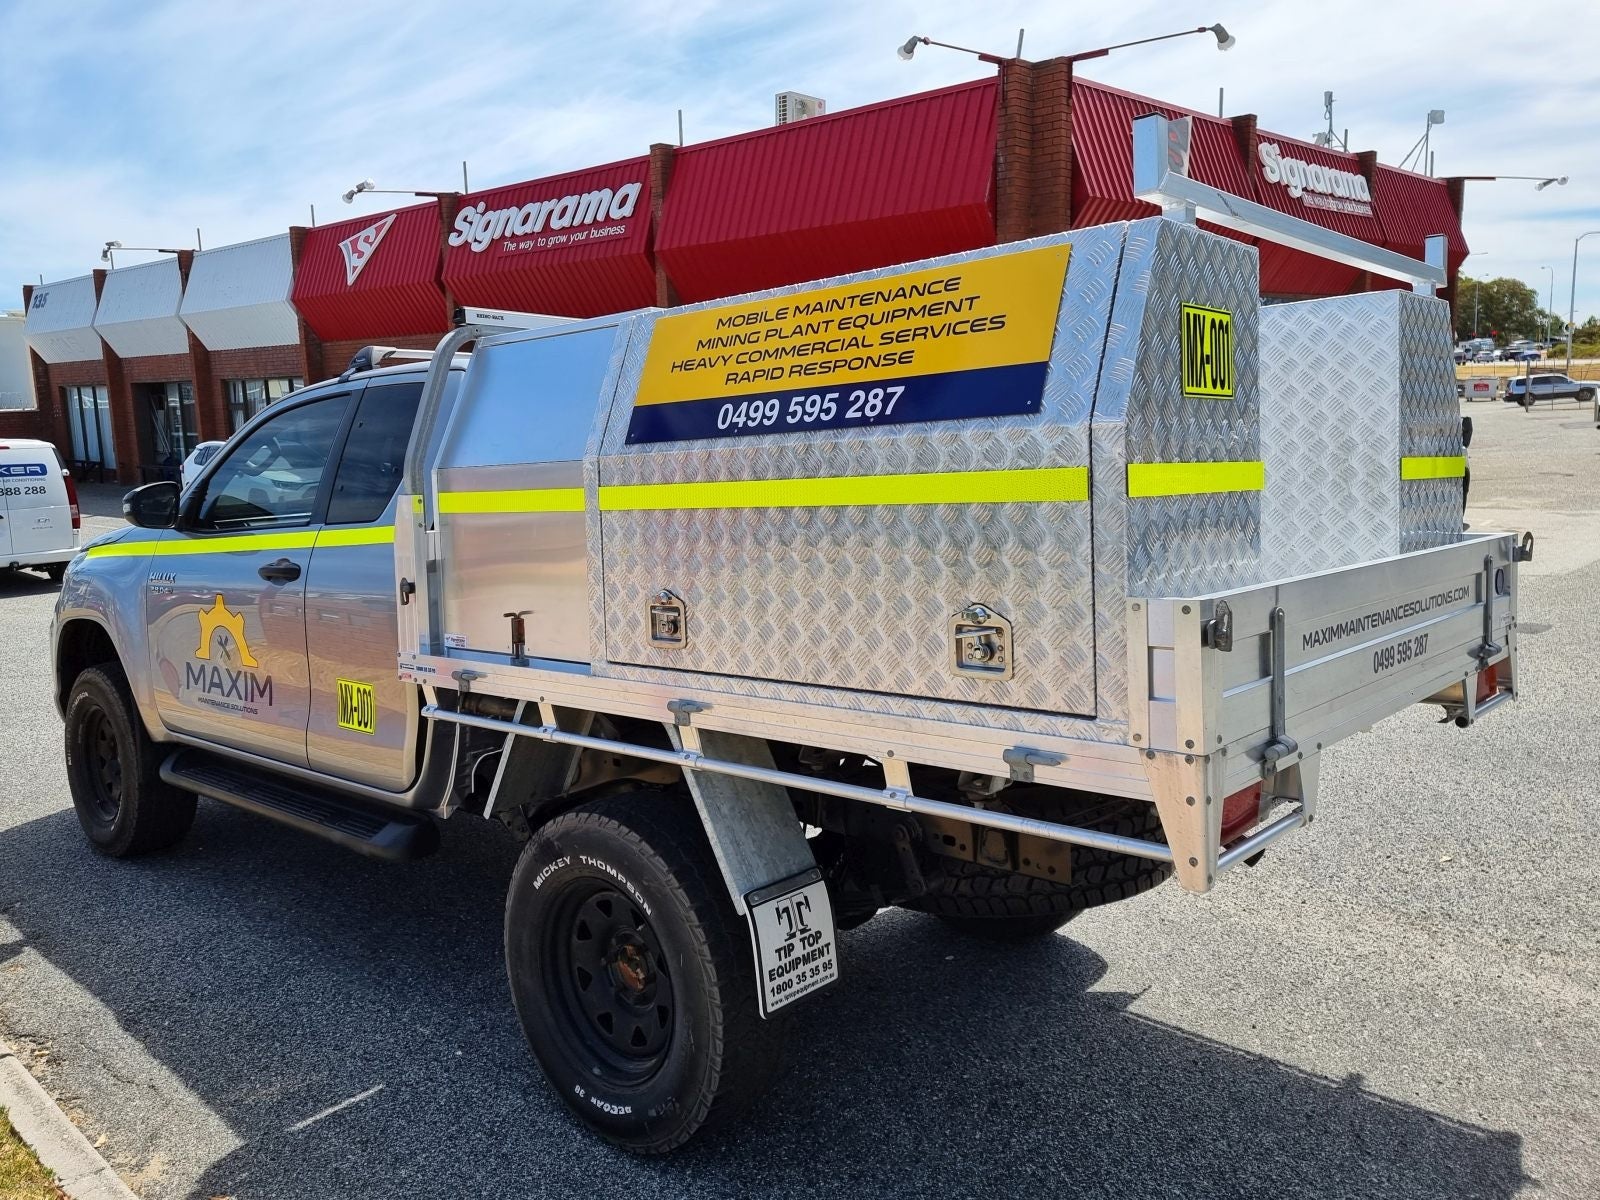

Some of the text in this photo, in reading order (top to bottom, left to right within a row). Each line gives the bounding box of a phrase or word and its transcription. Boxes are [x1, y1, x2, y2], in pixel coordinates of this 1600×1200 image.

[1258, 142, 1371, 202] Signarama
[448, 182, 642, 253] Signarama
[503, 225, 626, 252] The way to grow your business
[696, 295, 981, 352] MINING PLANT EQUIPMENT
[716, 276, 962, 331] MOBILE MAINTENANCE
[670, 314, 1007, 374] HEAVY COMMERCIAL SERVICES
[1185, 311, 1231, 391] MX-001
[724, 349, 915, 386] RAPID RESPONSE
[716, 385, 906, 430] 0499 595 287
[24, 485, 47, 495] 288
[1302, 585, 1470, 651] MAXIMMAINTENANCESOLUTIONS.COM
[1373, 633, 1429, 674] 0499 595 287
[185, 661, 273, 707] MAXIM
[197, 696, 259, 715] MAINTENANCE SOLUTIONS
[338, 682, 373, 730] MX-001
[532, 855, 652, 916] MICKEY THOMPSON
[768, 942, 831, 983] EQUIPMENT
[775, 930, 822, 962] TIP TOP
[770, 958, 833, 998] 1800 35 35 95
